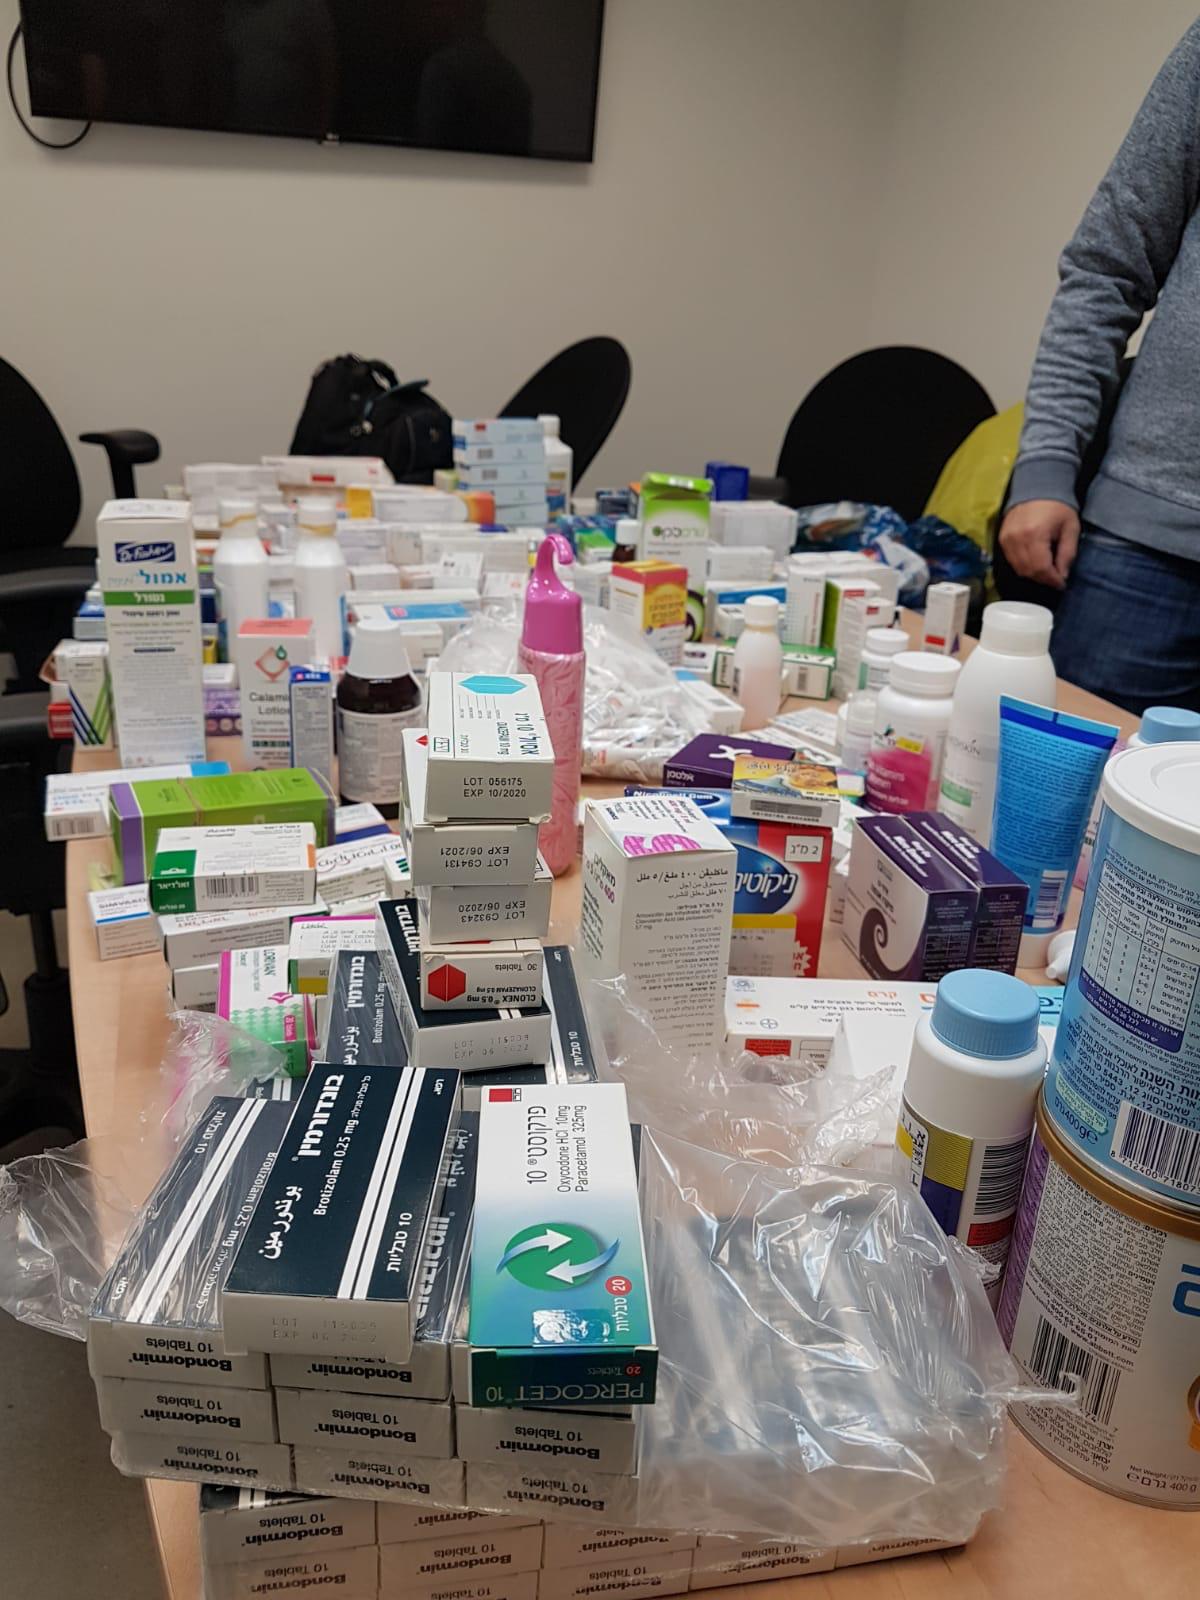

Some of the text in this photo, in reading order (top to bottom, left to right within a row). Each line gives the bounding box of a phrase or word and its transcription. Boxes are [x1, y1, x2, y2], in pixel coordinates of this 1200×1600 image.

[249, 692, 289, 704] Calami
[258, 706, 289, 716] Lotio
[463, 777, 484, 786] LOT
[463, 788, 527, 798] EXP 10/2020
[440, 845, 509, 856] EXP 06/2021
[811, 844, 819, 855] 2
[445, 858, 509, 868] LOT C94131
[734, 868, 798, 899] ניקוטינ
[458, 900, 526, 912] EXP 06/2020
[461, 911, 525, 923] LOT C93243
[527, 963, 537, 971] 30
[346, 955, 366, 1009] בונדורמין
[496, 985, 537, 993] CLONAZEPAM
[466, 994, 480, 1004] mg
[372, 1008, 384, 1044] Brotizolam
[454, 1040, 474, 1050] LOT
[1104, 1057, 1131, 1080] הרבנות
[1113, 1054, 1139, 1074] לאוכלי
[1103, 1068, 1123, 1086] 5443
[1132, 1074, 1164, 1096] ובאישור
[1140, 1068, 1175, 1089] השנה
[295, 1073, 346, 1158] בונדורמין
[194, 1141, 207, 1154] 10
[557, 1104, 572, 1194] Oxycodone HCl 10mg
[575, 1104, 589, 1193] Paracetamol 325mg
[312, 1118, 359, 1216] Brotizolam 0.25 mg
[526, 1169, 542, 1185] 10
[233, 1204, 254, 1228] 0.25
[221, 1229, 240, 1249] mg
[385, 1212, 413, 1273] 10 טבליות
[610, 1278, 629, 1333] 20 טבליות
[145, 1337, 213, 1352] 10 Tablets
[1070, 1326, 1135, 1367] www.abbott.com
[131, 1352, 233, 1372] Bondormin
[587, 1365, 641, 1377] 20 Tablets
[309, 1363, 413, 1383] Bondormin
[485, 1382, 645, 1403] PERCOCET 10
[156, 1394, 223, 1411] 10 Tablets
[143, 1408, 241, 1429] Bondormin
[332, 1408, 399, 1426] 10 Tablets
[317, 1423, 416, 1444] Bondormin
[514, 1425, 583, 1442] 10 Tablets
[176, 1445, 240, 1462] 10 Tablets
[499, 1439, 601, 1460] Bondormin
[163, 1458, 259, 1478] Bondormin
[347, 1459, 413, 1477] 10 Tablets
[1130, 1464, 1142, 1473] Net
[333, 1472, 431, 1495] Bondormin
[521, 1475, 588, 1494] 10 Tablets
[1169, 1481, 1189, 1492] 400
[1189, 1480, 1198, 1493] g
[506, 1489, 606, 1512] Bondormin
[259, 1512, 326, 1529] 10 Tablets
[244, 1525, 344, 1547] Bondormin
[434, 1542, 496, 1558] 10 Tablets
[741, 1544, 799, 1560] 10 Tablets
[264, 1563, 328, 1578] 10 Tablets
[419, 1553, 512, 1575] Bondormin
[589, 1566, 647, 1582] 10 Tablets
[251, 1574, 347, 1594] Bondormin
[430, 1586, 492, 1600] 10 Tablets
